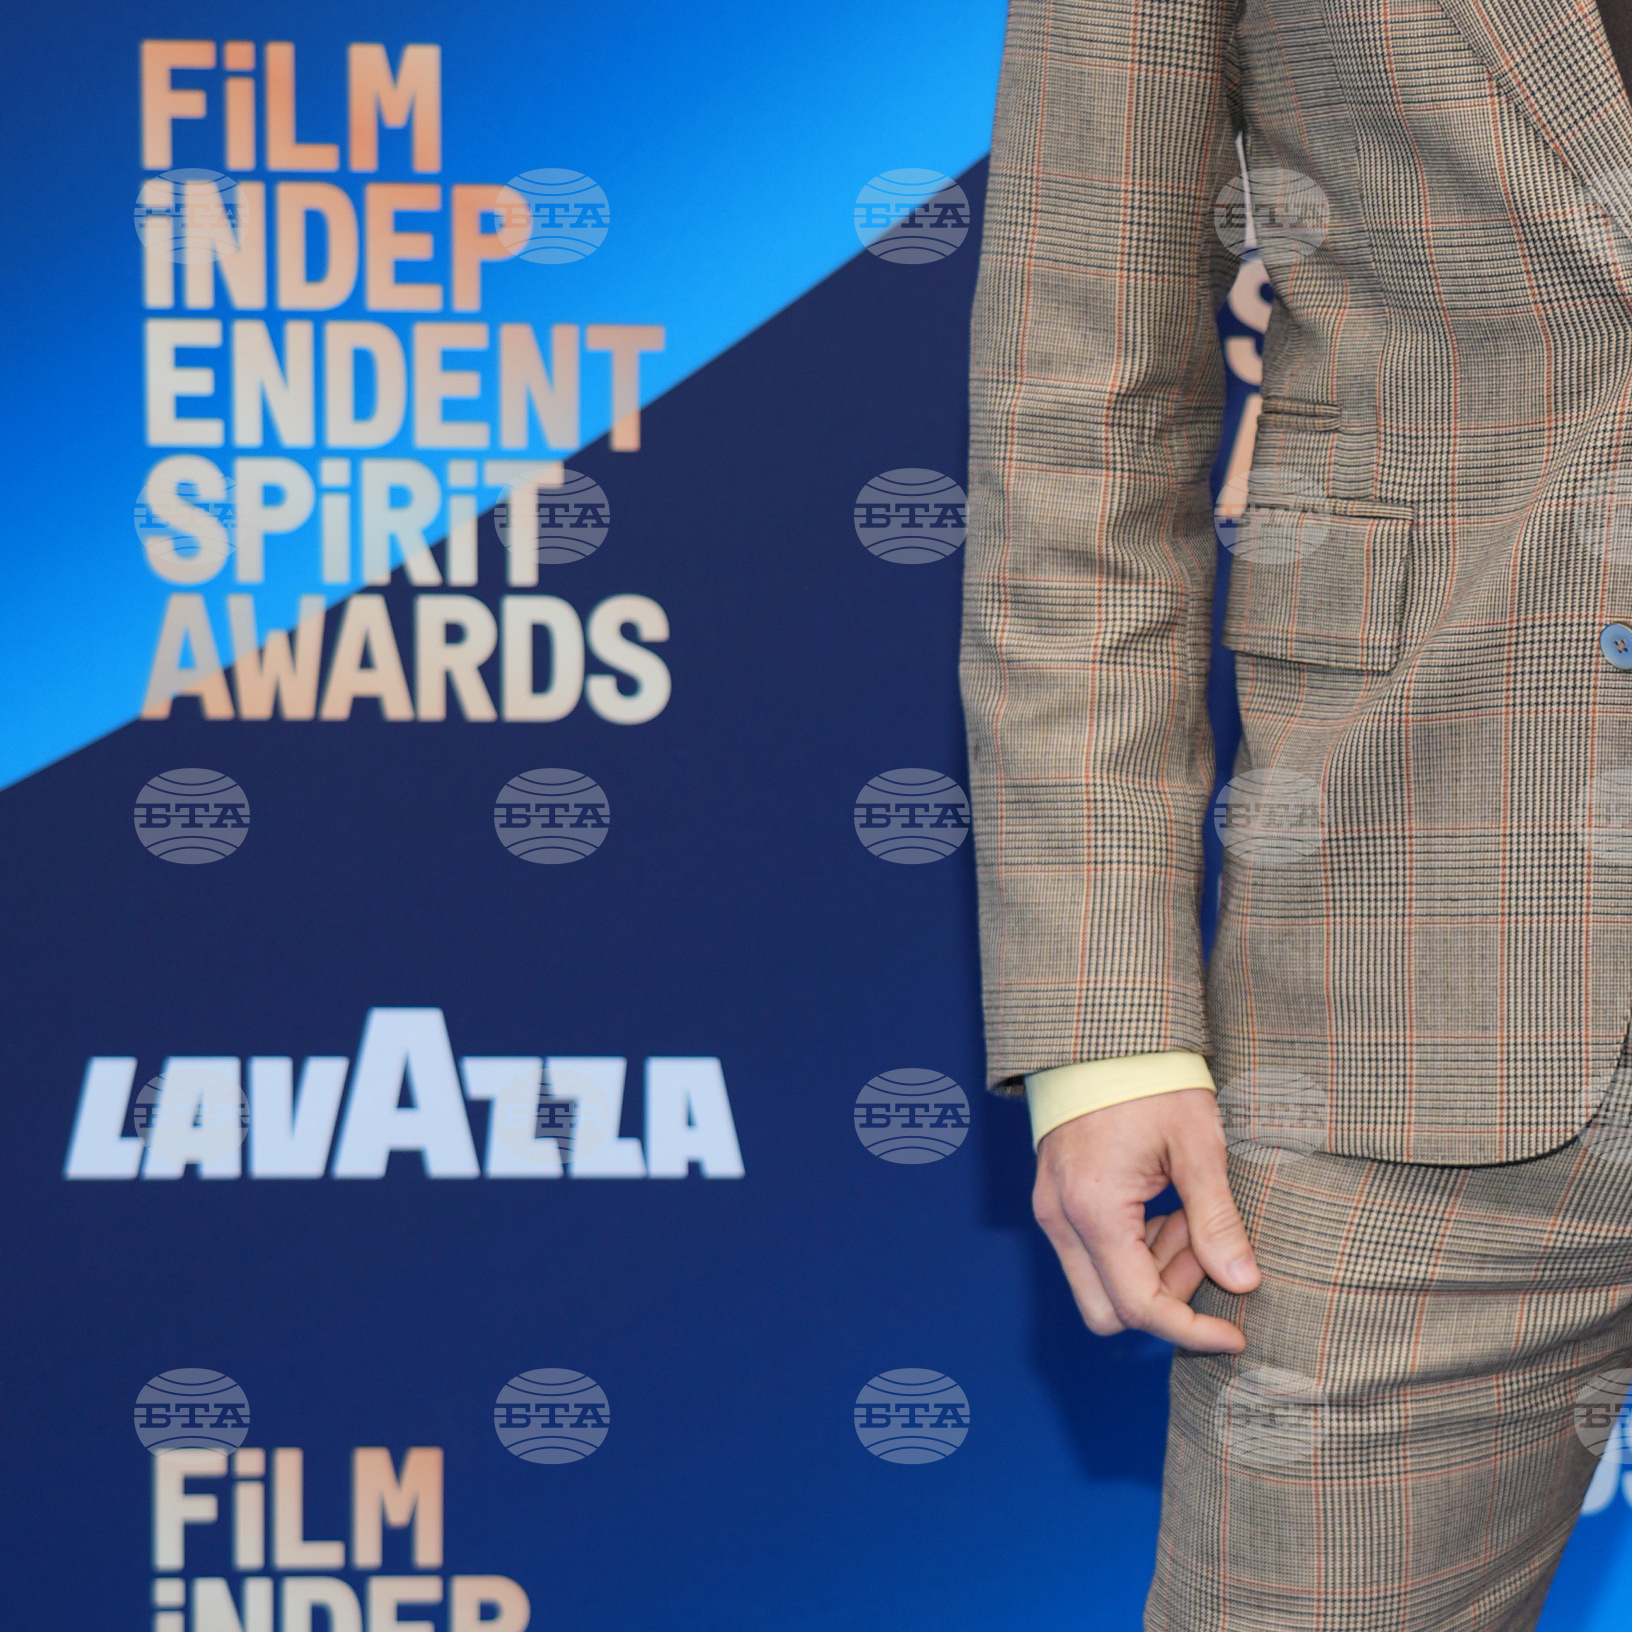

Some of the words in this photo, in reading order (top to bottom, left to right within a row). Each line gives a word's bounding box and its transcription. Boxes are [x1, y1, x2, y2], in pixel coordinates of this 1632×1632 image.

[140, 39, 442, 174] FiLM
[140, 178, 534, 312] iNDEP
[145, 318, 666, 452] ENDENT
[144, 454, 566, 588] SPiRiT
[141, 593, 672, 725] AWARDS
[68, 1008, 743, 1178] LAVAZZA
[155, 1446, 444, 1570] FiLM
